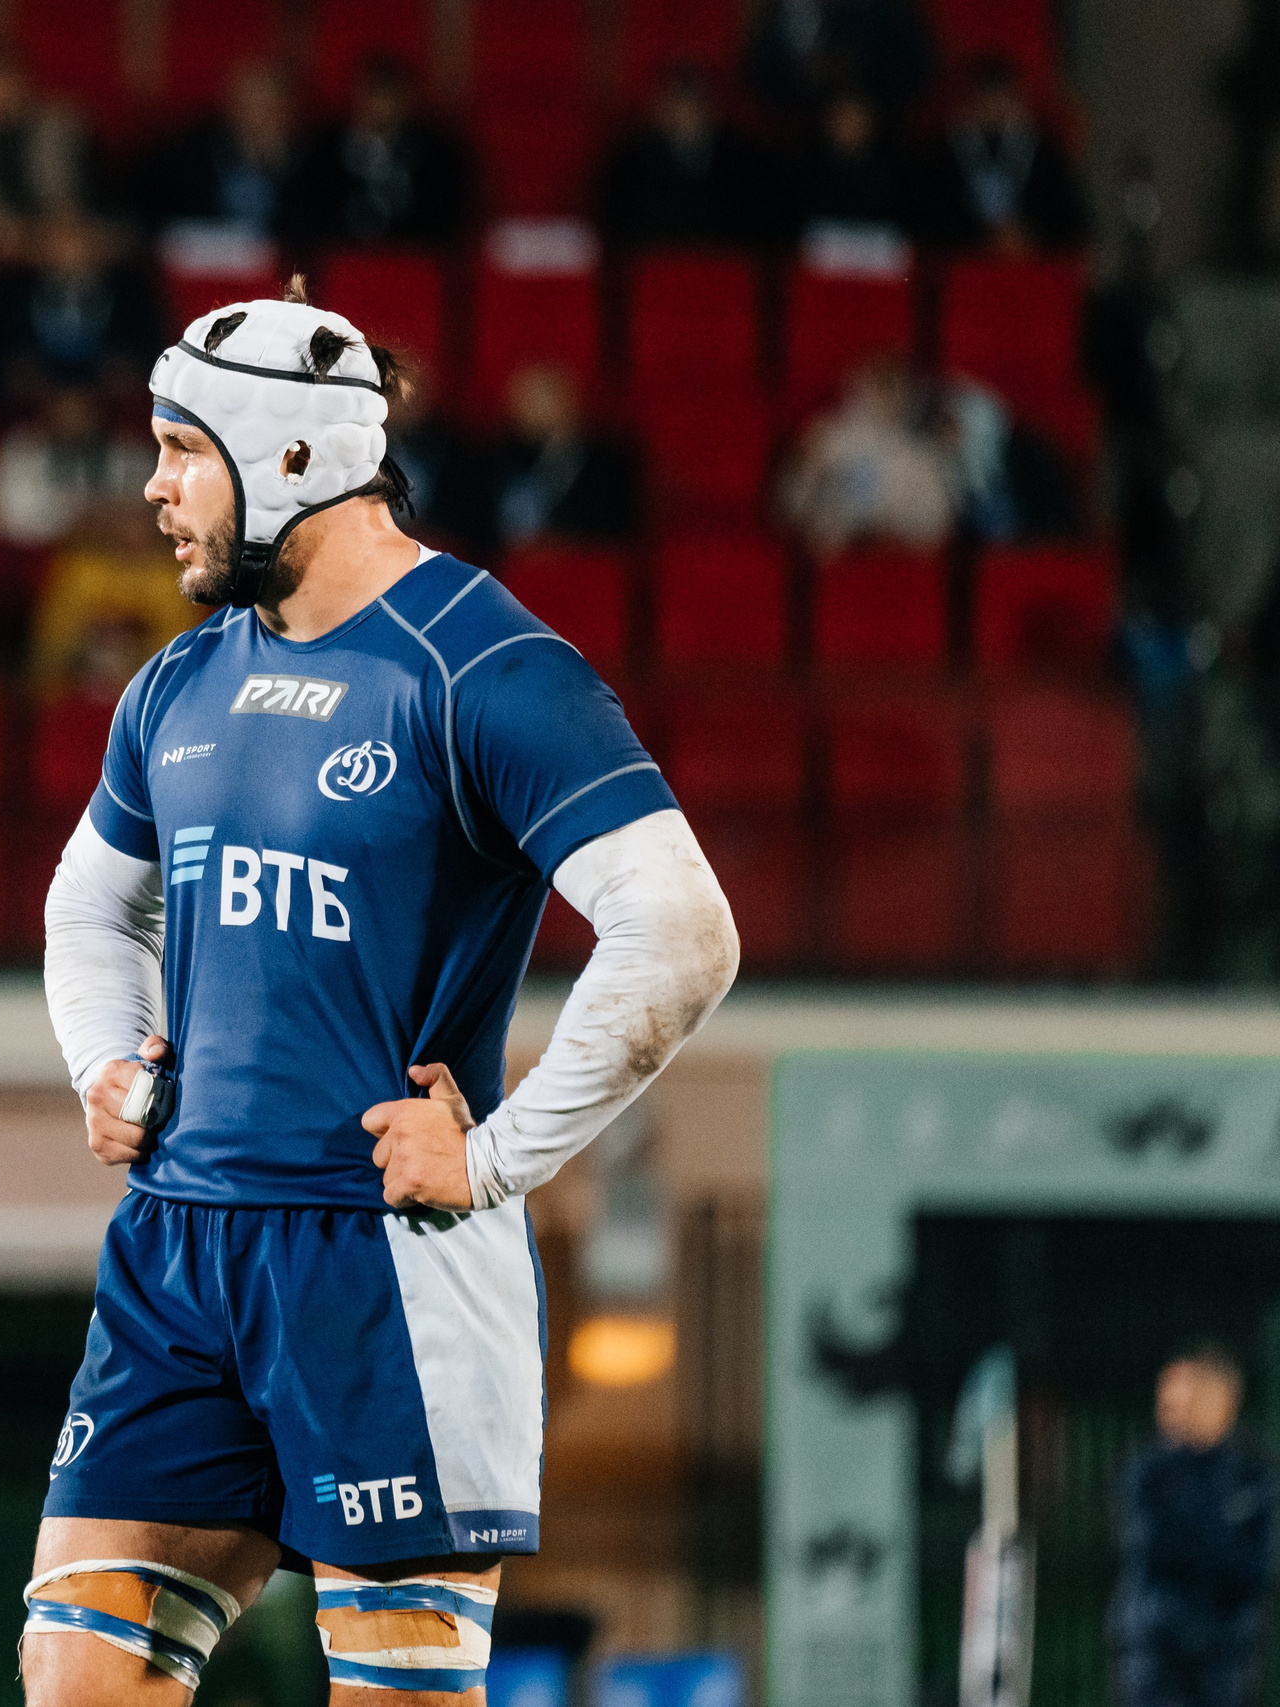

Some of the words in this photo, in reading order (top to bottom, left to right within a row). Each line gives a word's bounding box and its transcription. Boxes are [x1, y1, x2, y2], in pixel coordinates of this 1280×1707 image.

[234, 678, 342, 717] PARI
[185, 743, 217, 755] SPORT
[219, 845, 351, 942] ВТБ
[338, 1475, 423, 1526] ВТБ
[500, 1529, 528, 1538] SPORT
